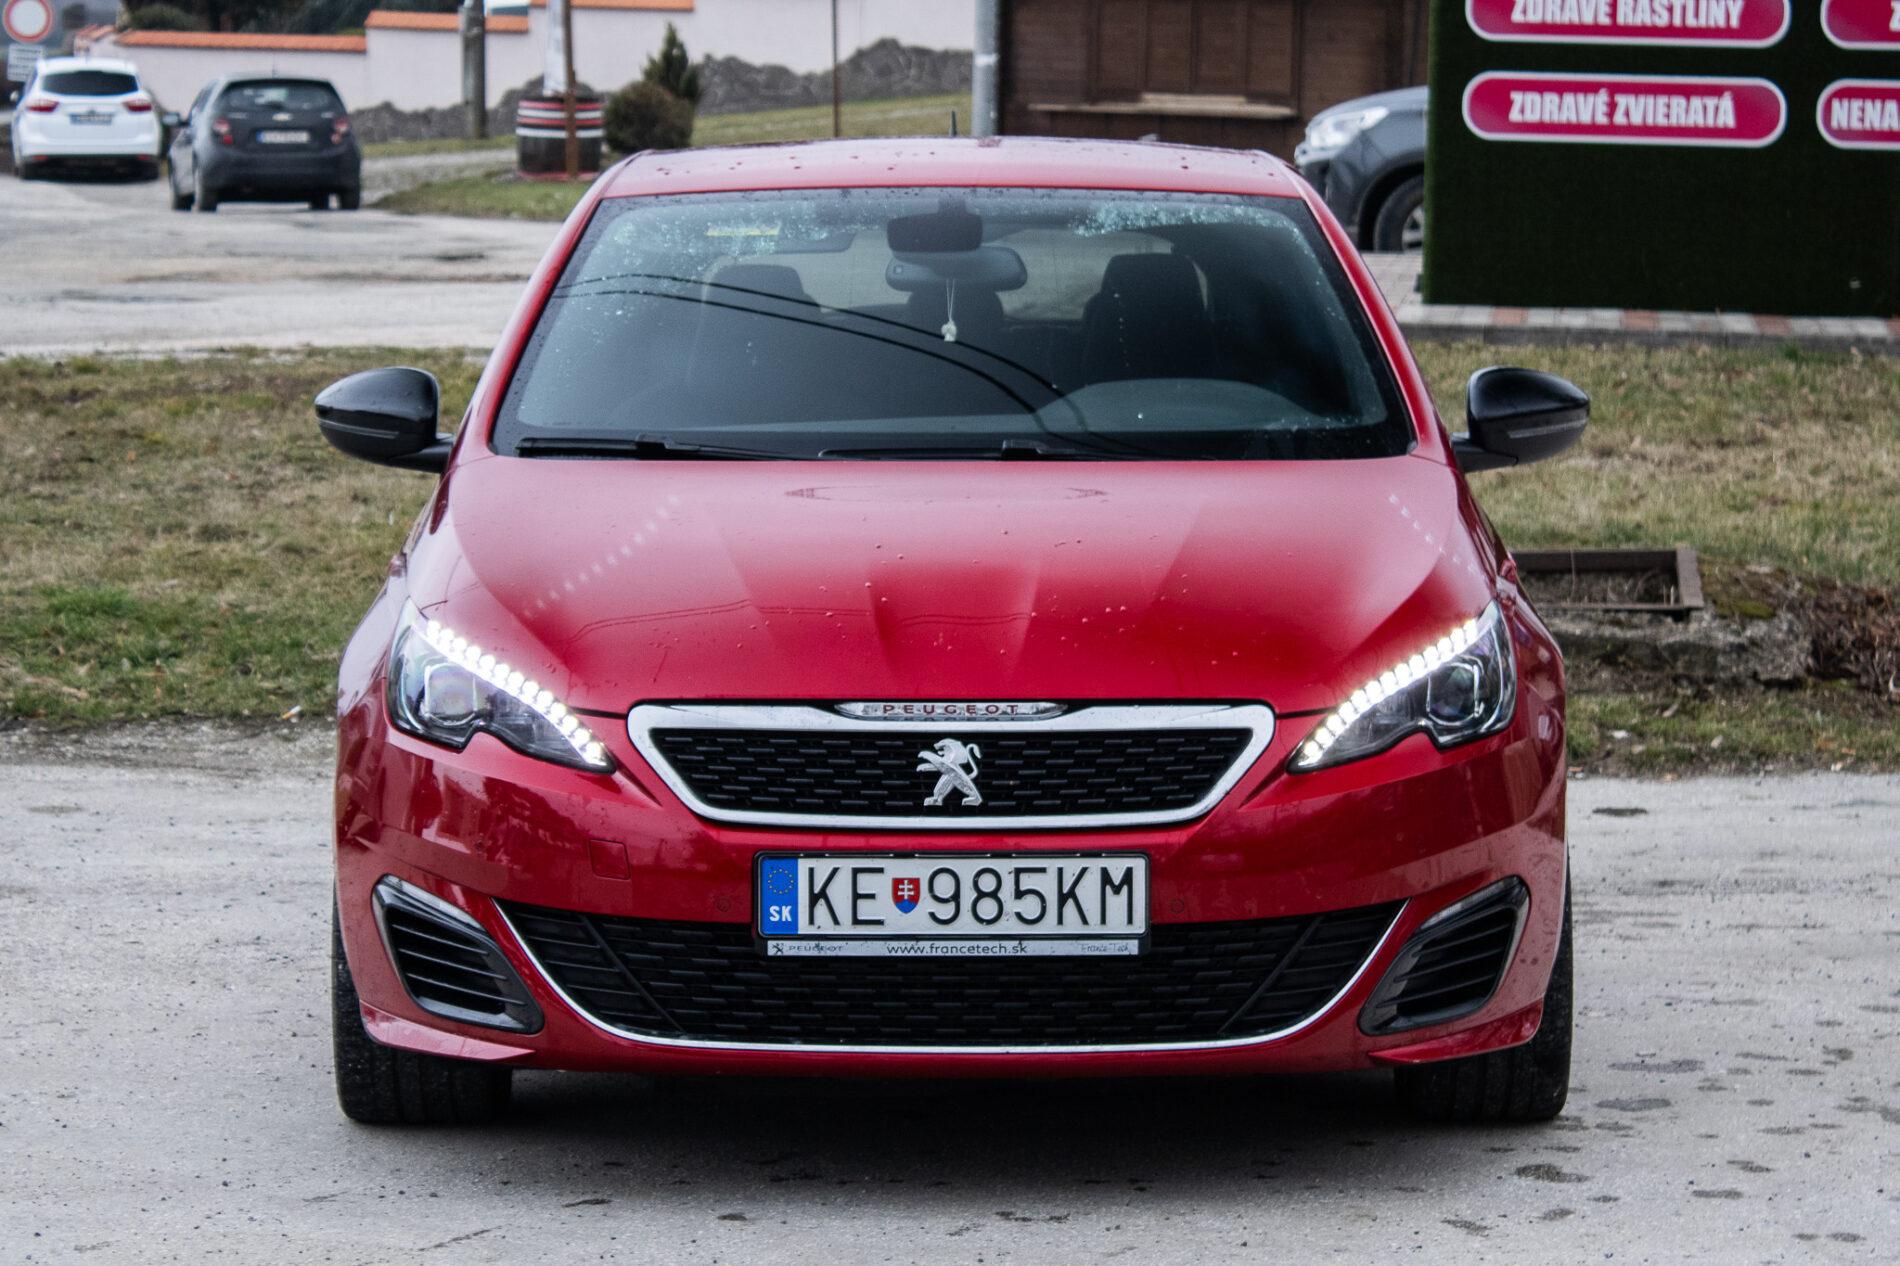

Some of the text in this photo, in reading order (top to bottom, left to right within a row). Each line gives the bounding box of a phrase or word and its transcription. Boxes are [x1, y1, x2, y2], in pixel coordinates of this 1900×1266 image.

[1616, 0, 1744, 28] RASTLINY
[1508, 87, 1736, 129] ZDRAVÉ ZVIERATÁ
[882, 704, 1019, 716] PEUGEOT
[808, 866, 1134, 926] KE 985KM
[769, 905, 793, 922] SK
[886, 942, 1028, 955] www.francetech.sk
